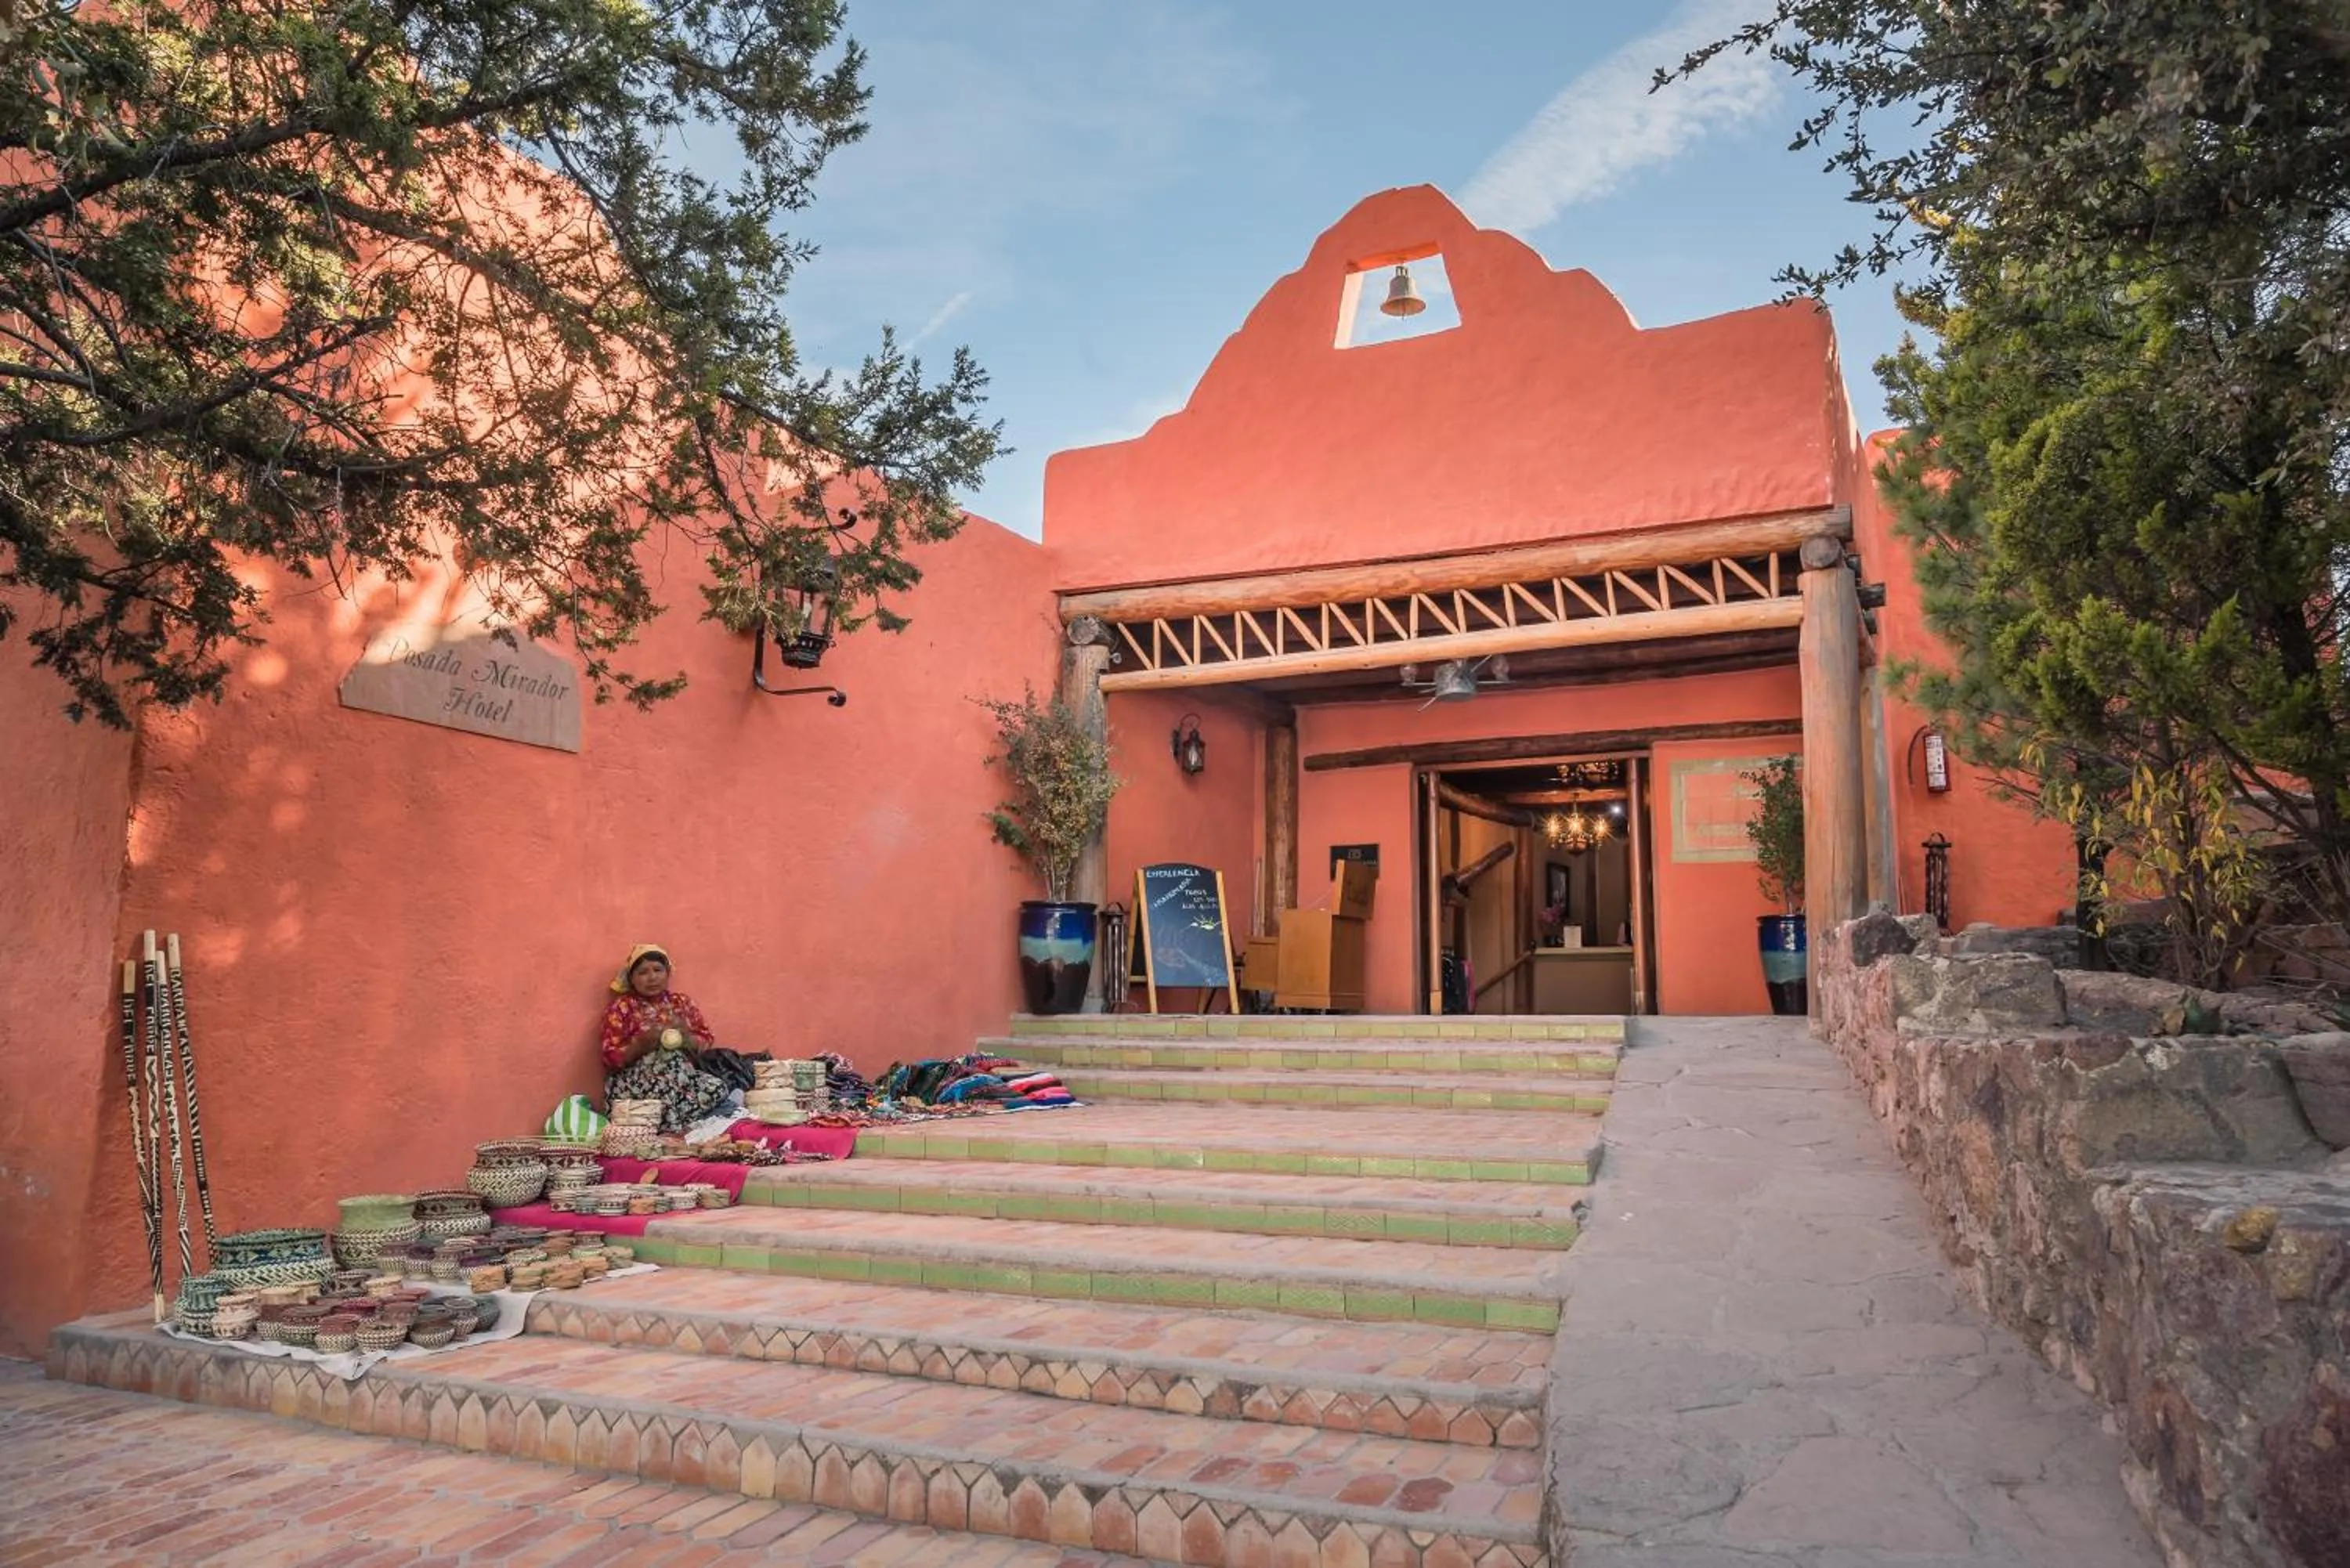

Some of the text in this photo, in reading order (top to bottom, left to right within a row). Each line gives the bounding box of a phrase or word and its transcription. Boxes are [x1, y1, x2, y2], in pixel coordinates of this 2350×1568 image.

[388, 635, 570, 700] Posada Mirador
[443, 687, 514, 723] Hotel
[170, 967, 190, 1056] BARRANCAS
